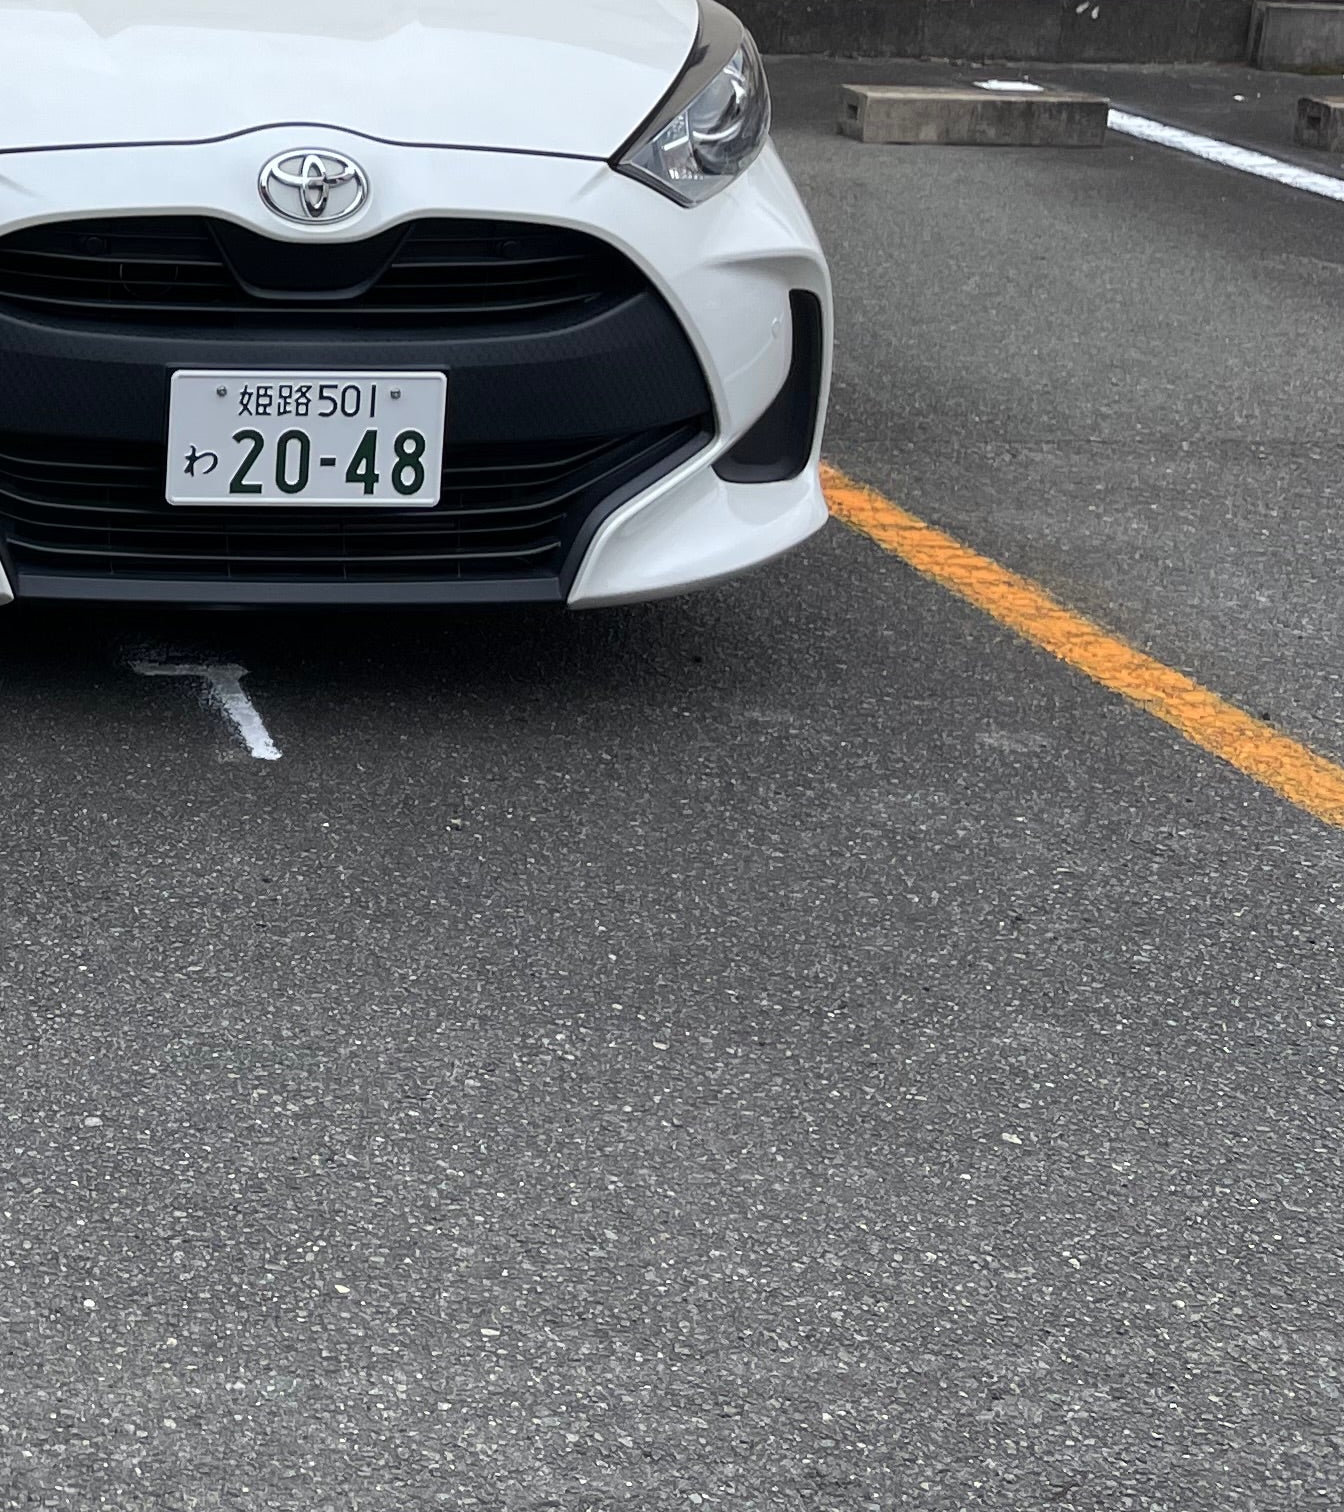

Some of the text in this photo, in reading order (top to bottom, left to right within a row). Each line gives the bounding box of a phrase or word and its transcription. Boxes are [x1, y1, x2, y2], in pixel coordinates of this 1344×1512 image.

[184, 429, 426, 496] わ 20-48
[128, 661, 283, 761] 7
